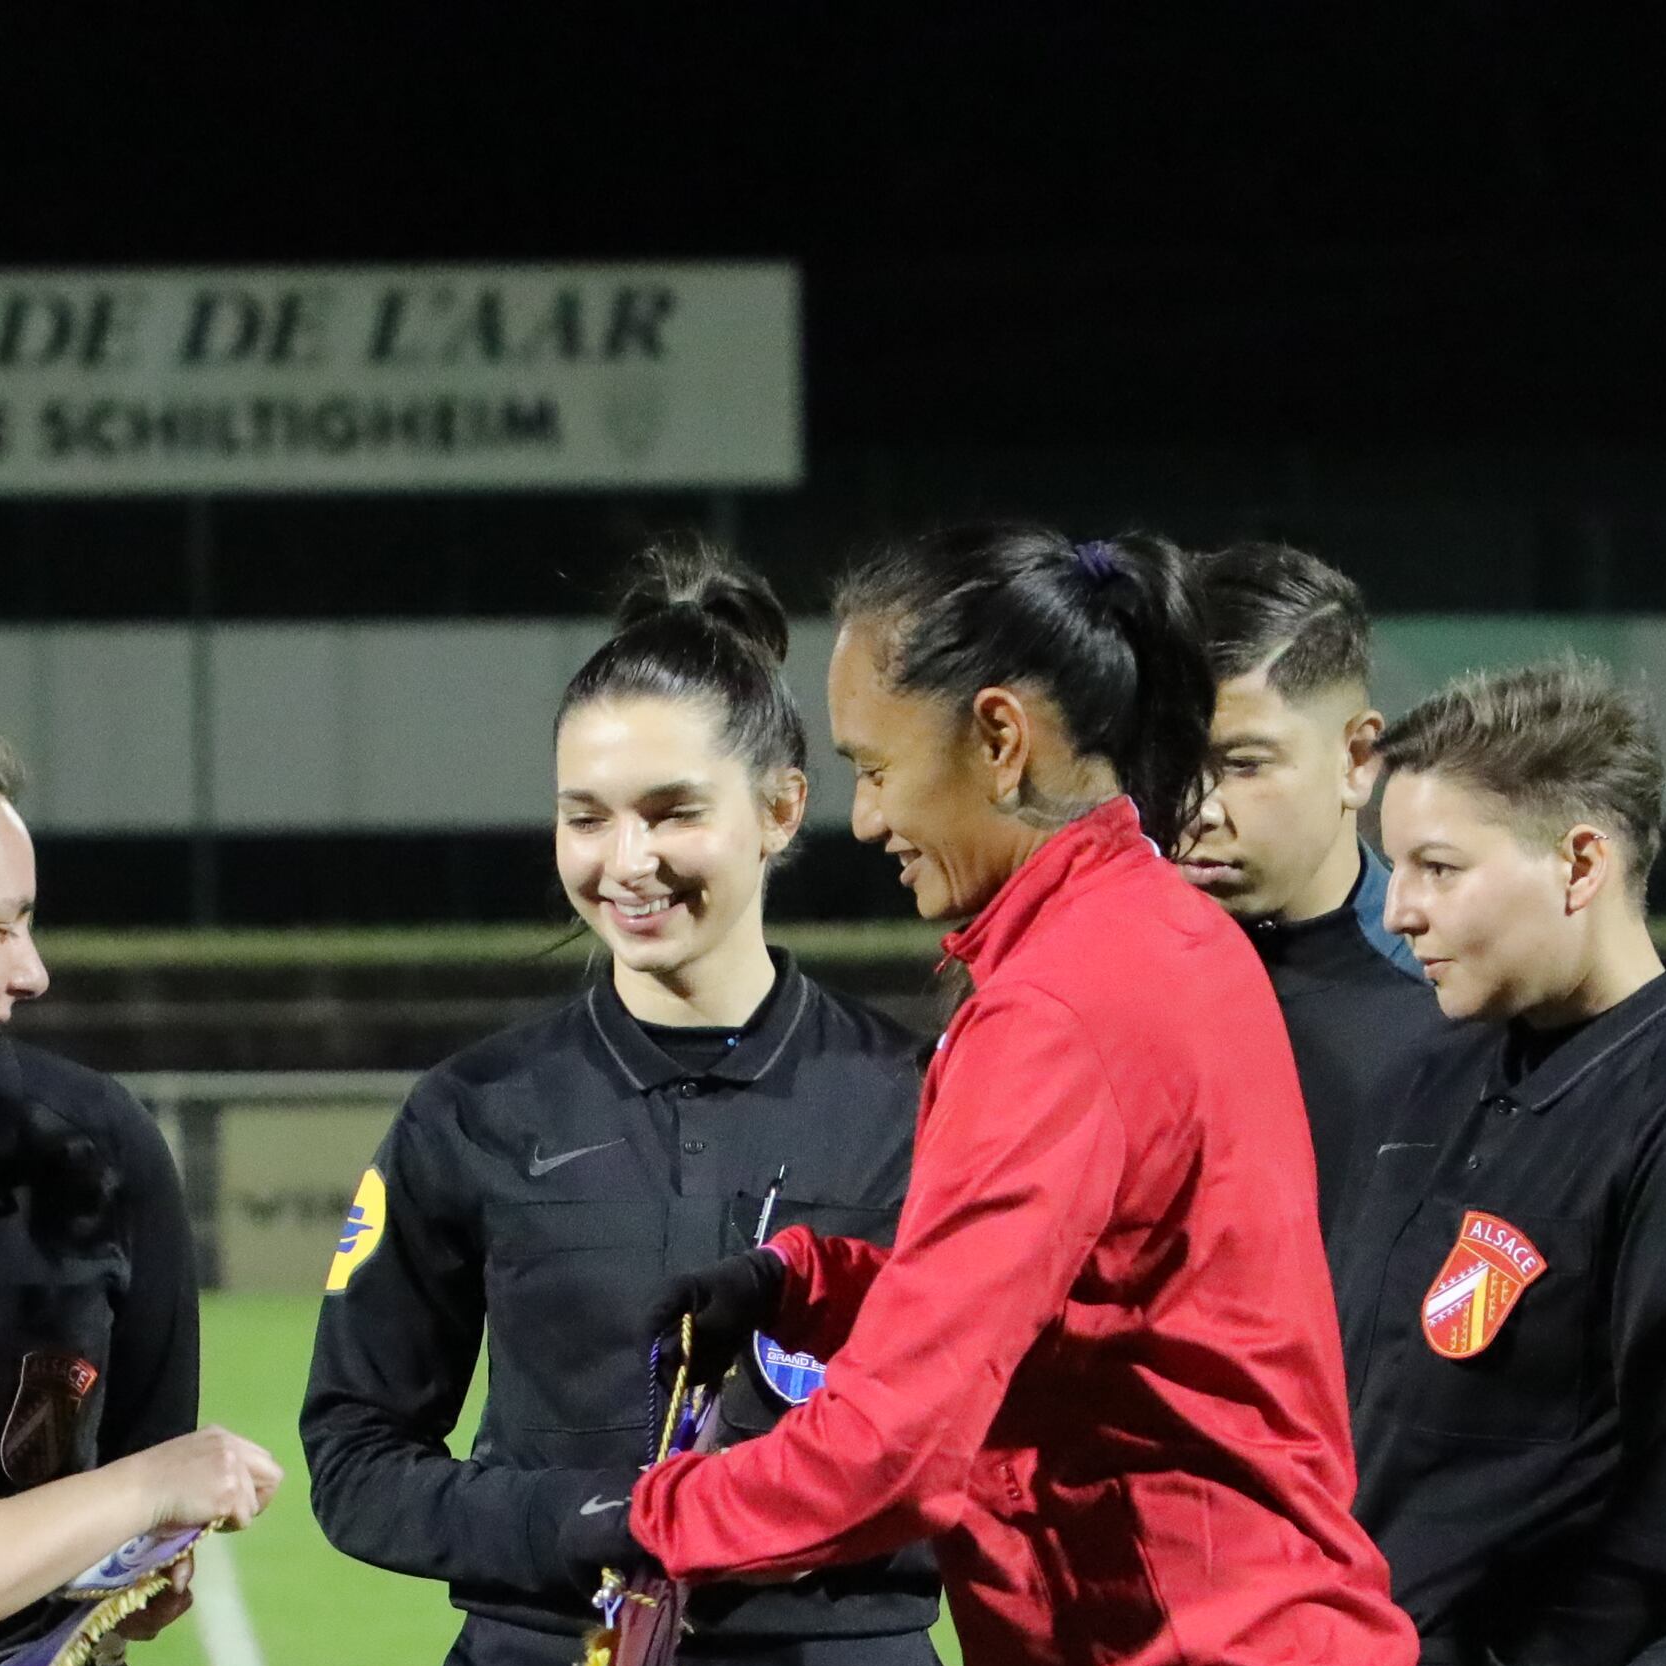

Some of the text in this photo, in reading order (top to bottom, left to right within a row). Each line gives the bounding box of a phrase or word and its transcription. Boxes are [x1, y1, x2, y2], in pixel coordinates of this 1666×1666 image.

[179, 288, 341, 369] DE
[36, 391, 566, 460] SCHILTIGHEIM
[1468, 1219, 1537, 1274] ALSACE
[766, 1350, 809, 1367] GRAND
